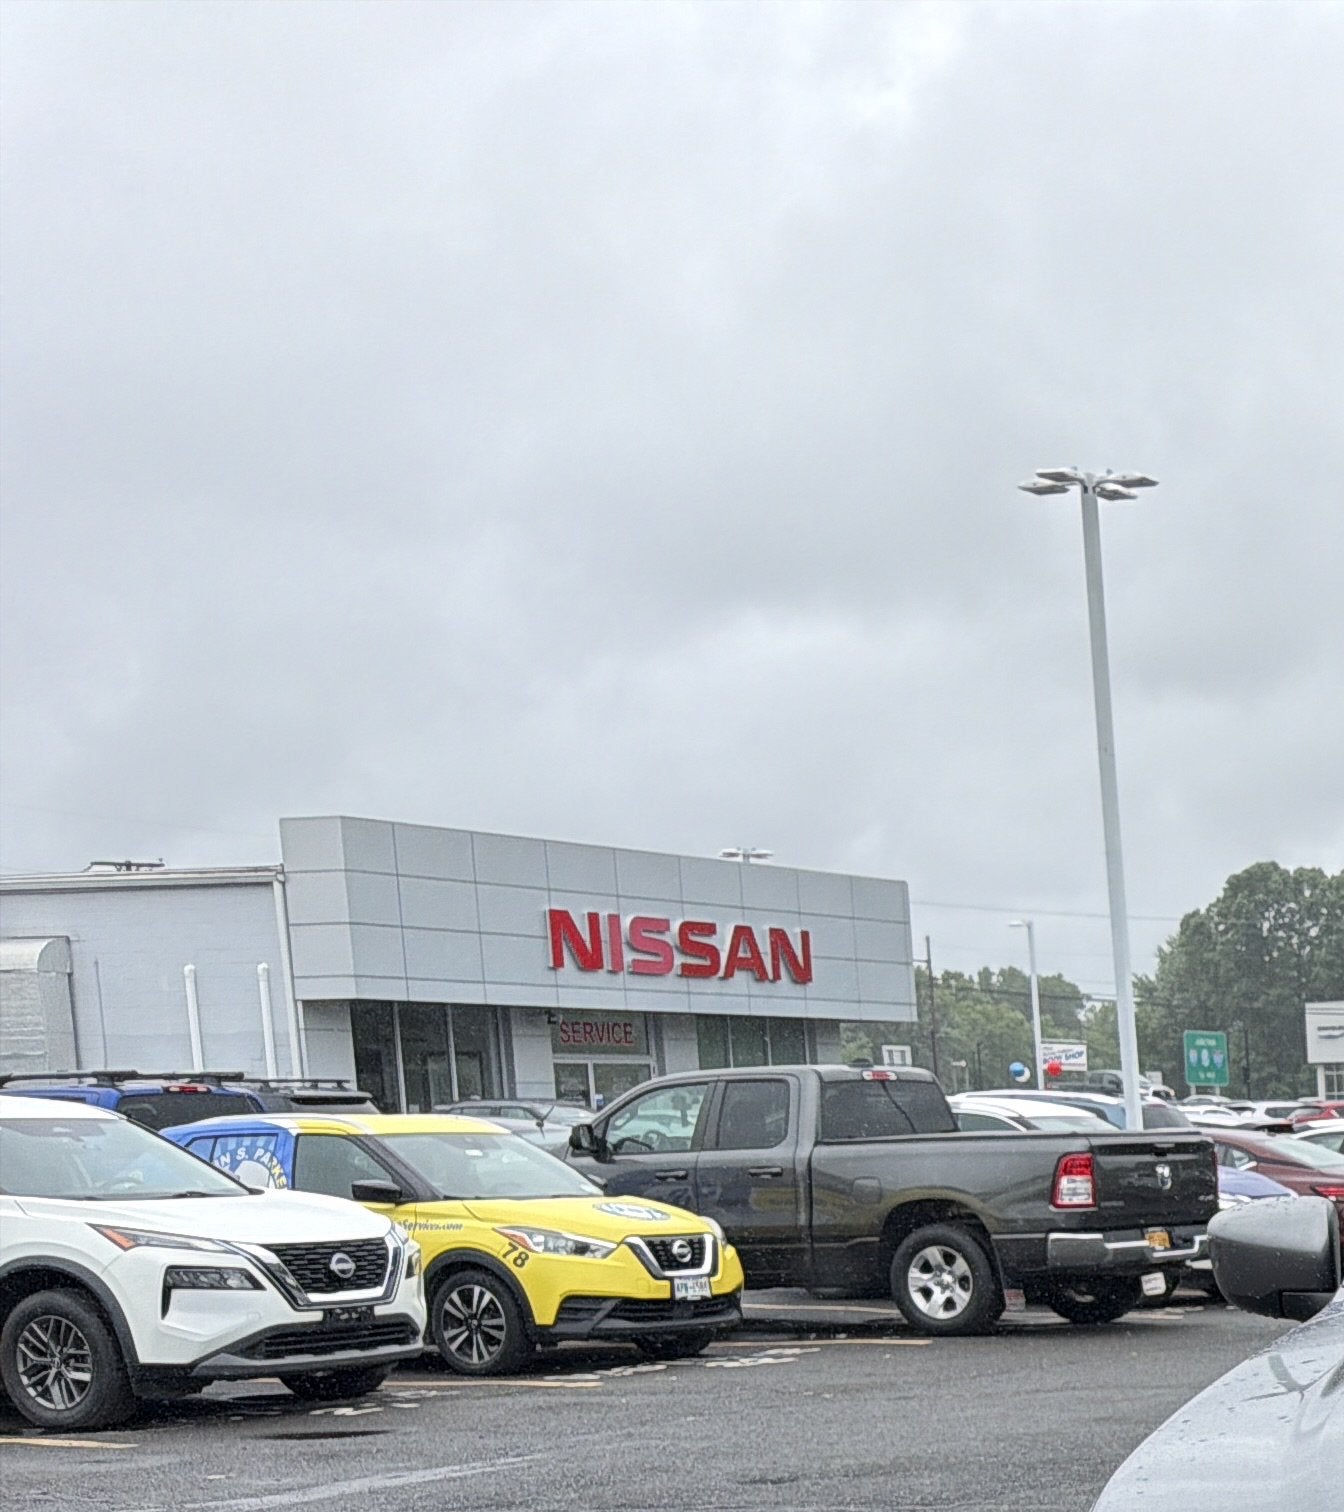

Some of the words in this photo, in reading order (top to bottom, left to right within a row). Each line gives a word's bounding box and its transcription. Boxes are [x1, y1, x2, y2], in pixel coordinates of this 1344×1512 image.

[549, 908, 813, 984] NISSAN
[559, 1020, 634, 1045] SERVICE
[501, 1241, 530, 1268] 78
